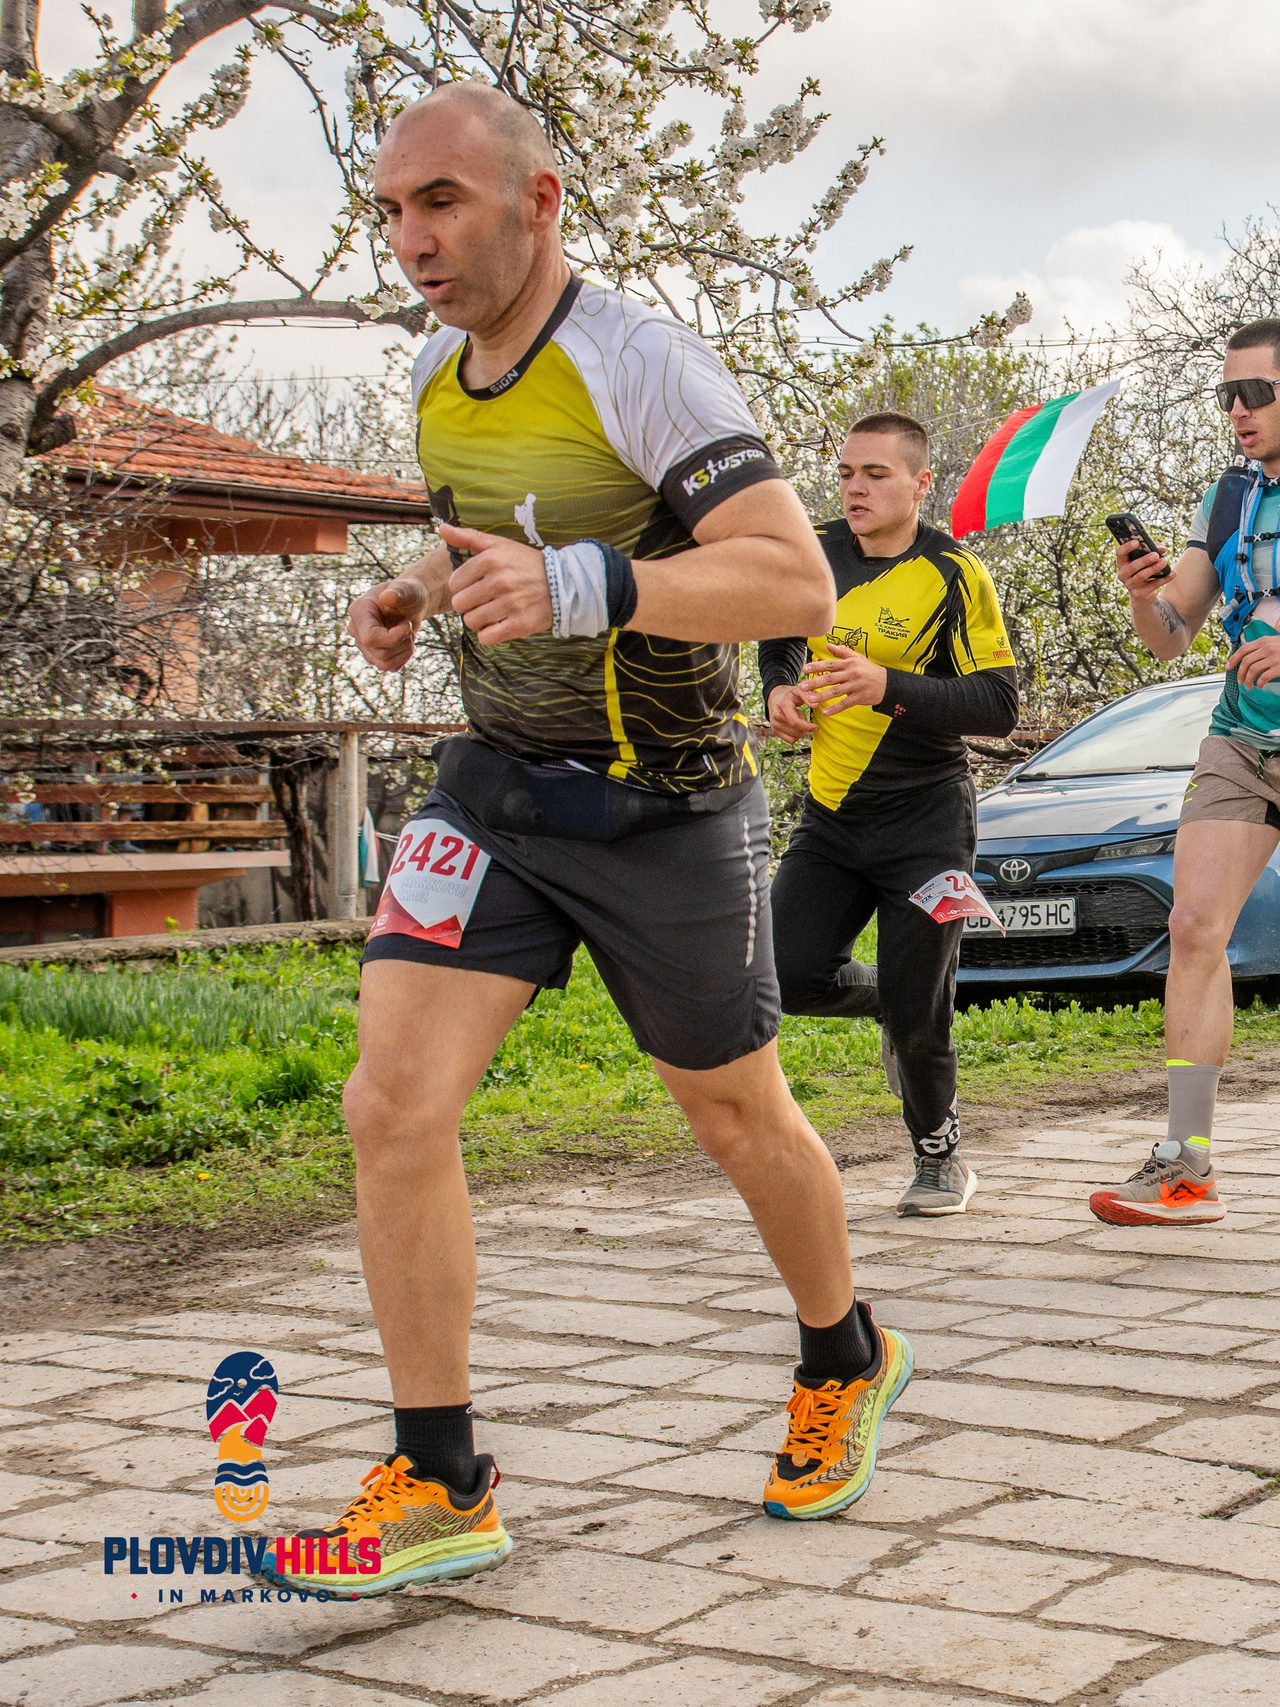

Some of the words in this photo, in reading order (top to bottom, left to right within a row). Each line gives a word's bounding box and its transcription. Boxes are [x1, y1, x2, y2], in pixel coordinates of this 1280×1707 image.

[877, 627, 908, 638] ТРАКИЯ
[390, 832, 481, 881] 2421
[401, 876, 468, 897] MARKOVO
[998, 904, 1042, 928] 4795
[1046, 903, 1071, 925] HC
[854, 1388, 877, 1449] HOKA
